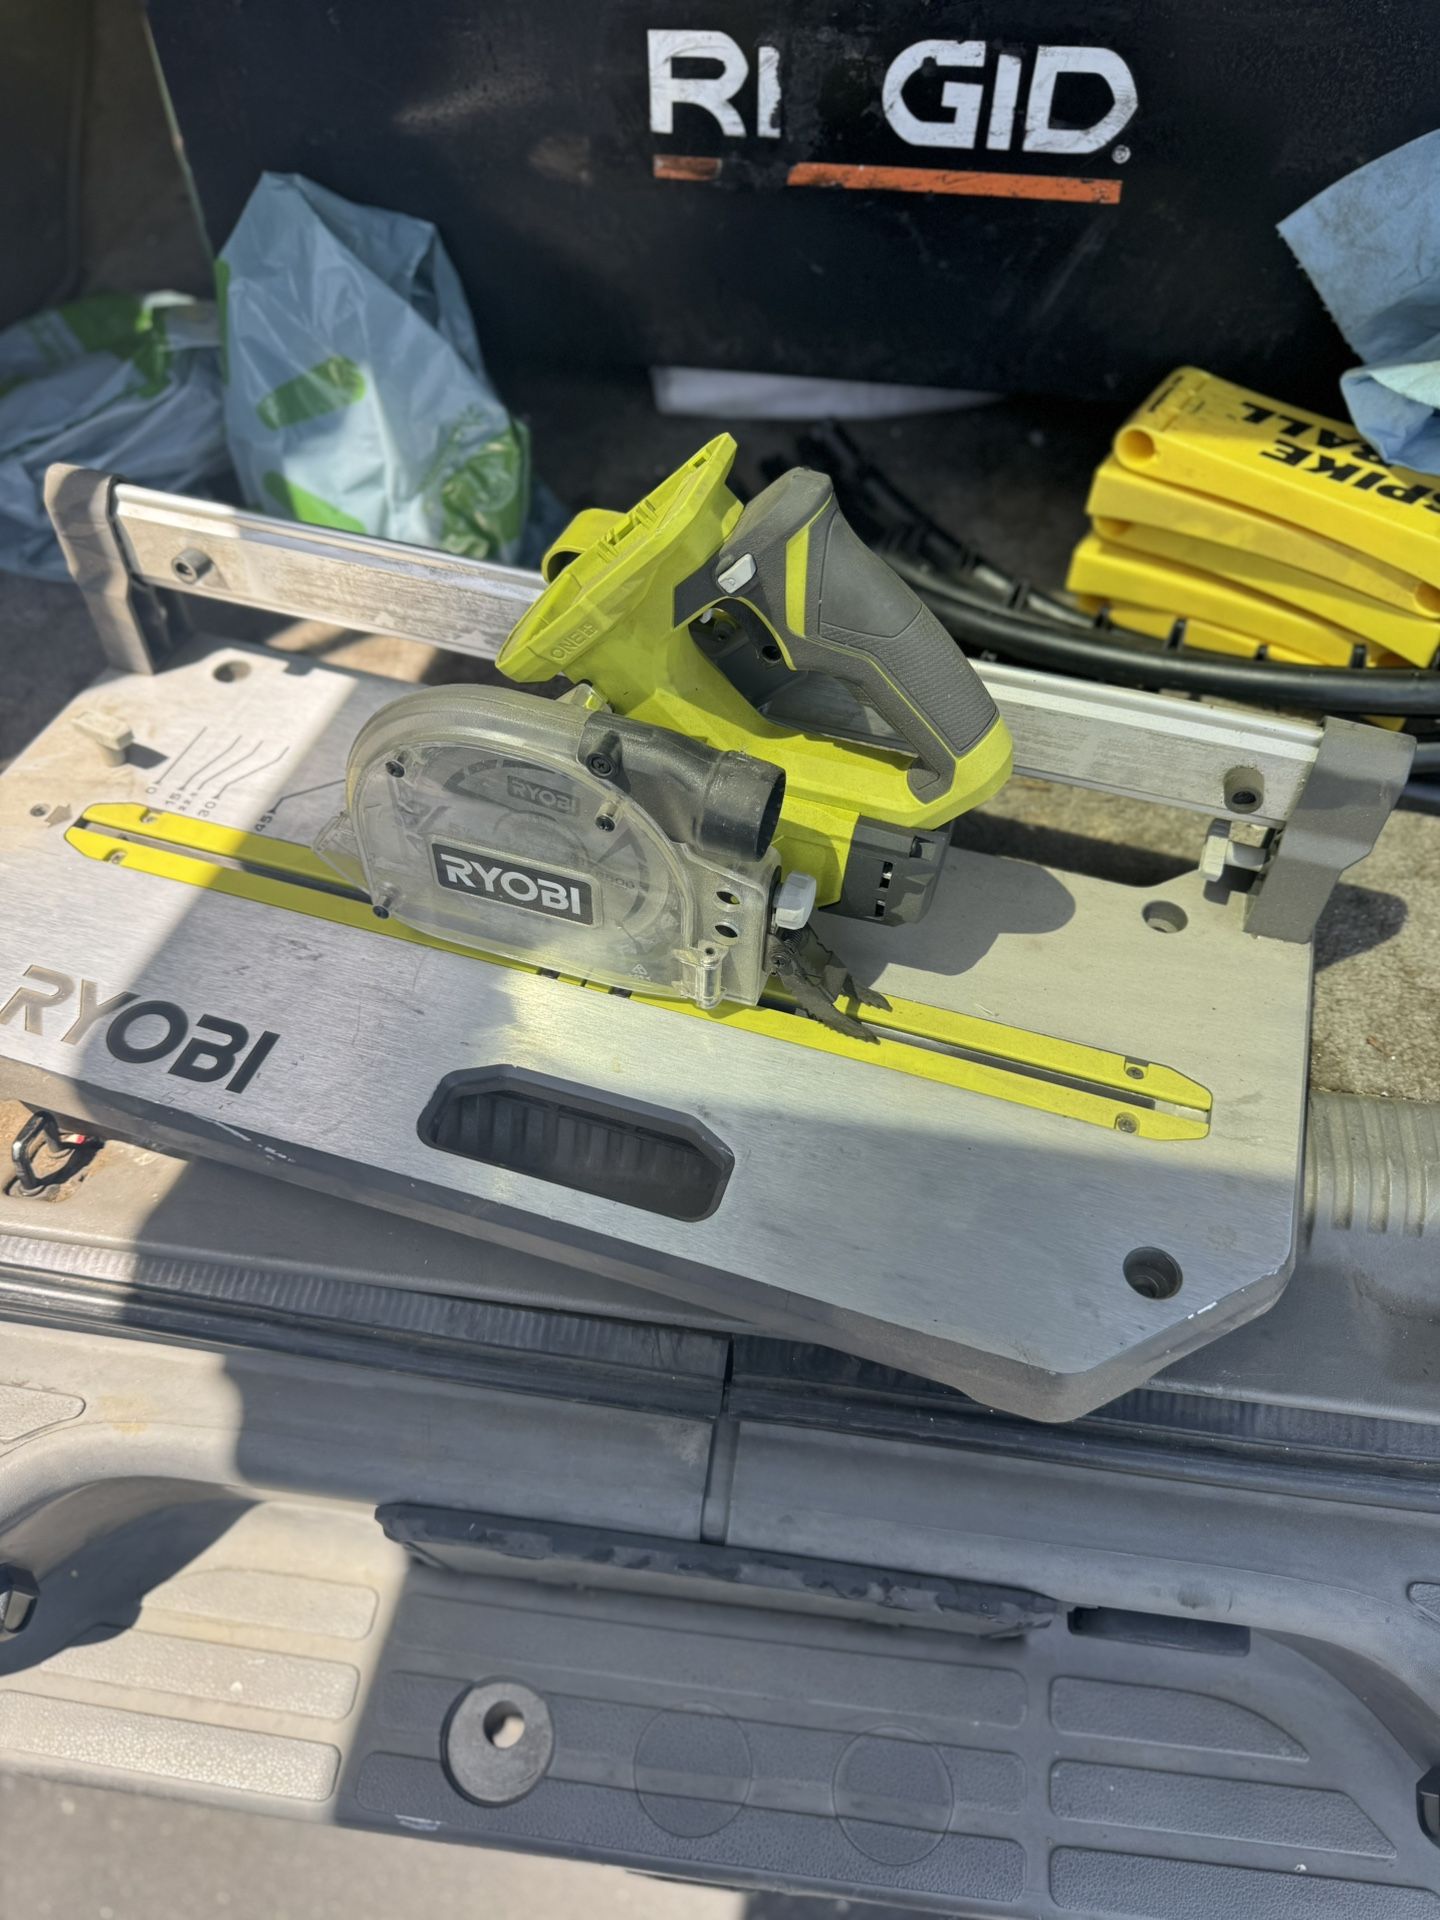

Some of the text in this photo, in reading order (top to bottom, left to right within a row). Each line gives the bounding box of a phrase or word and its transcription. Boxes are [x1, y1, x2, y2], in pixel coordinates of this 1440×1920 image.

[647, 29, 1138, 153] RIGID
[254, 814, 274, 832] 45
[511, 778, 577, 814] RYOBI
[440, 853, 582, 915] RYOBI
[0, 964, 281, 1094] RYOBI
